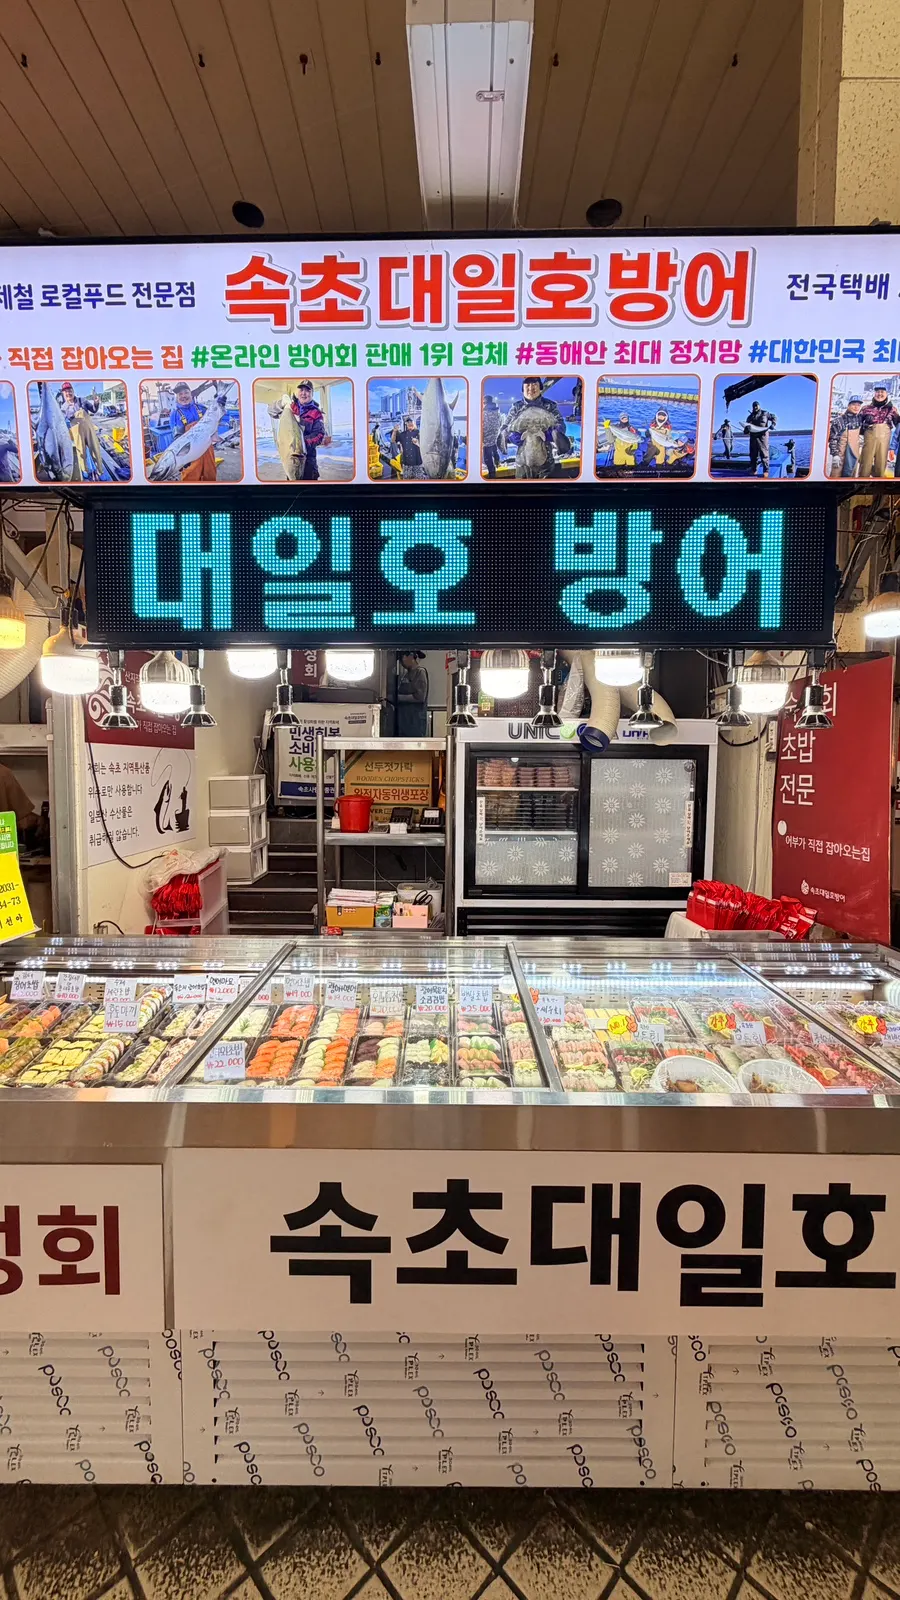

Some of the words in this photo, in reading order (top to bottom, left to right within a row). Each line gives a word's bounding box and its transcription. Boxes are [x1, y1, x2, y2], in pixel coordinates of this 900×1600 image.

[40, 283, 127, 309] 로컬푸드
[131, 281, 196, 308] 전문점
[786, 273, 890, 301] 전국택배
[7, 347, 54, 371] 직접
[60, 346, 155, 370] 잡아오는
[161, 346, 185, 370] 집
[191, 344, 280, 369] #온라인
[288, 344, 358, 368] 방어회
[365, 343, 412, 368] 판매
[419, 342, 452, 367] 1위
[462, 341, 508, 366] 업체
[516, 340, 607, 366] #동해안
[614, 339, 662, 365] 최대
[670, 339, 742, 365] 정치망
[748, 338, 866, 364] #대한민국
[130, 511, 477, 630] 대일호
[553, 510, 785, 629] 방어
[780, 730, 817, 763] 초밥
[108, 762, 122, 775] 속초
[364, 761, 414, 773] 선두젓가락
[383, 775, 425, 783] CHOPSTICKS
[115, 783, 143, 797] 사용합니다
[779, 773, 816, 806] 전문
[109, 805, 133, 820] 수산물은
[785, 835, 806, 850] 어부가
[807, 838, 824, 854] 직접
[825, 841, 870, 862] 잡아오는집
[0, 1205, 121, 1297] 회
[269, 1178, 897, 1308] 속초대일호
